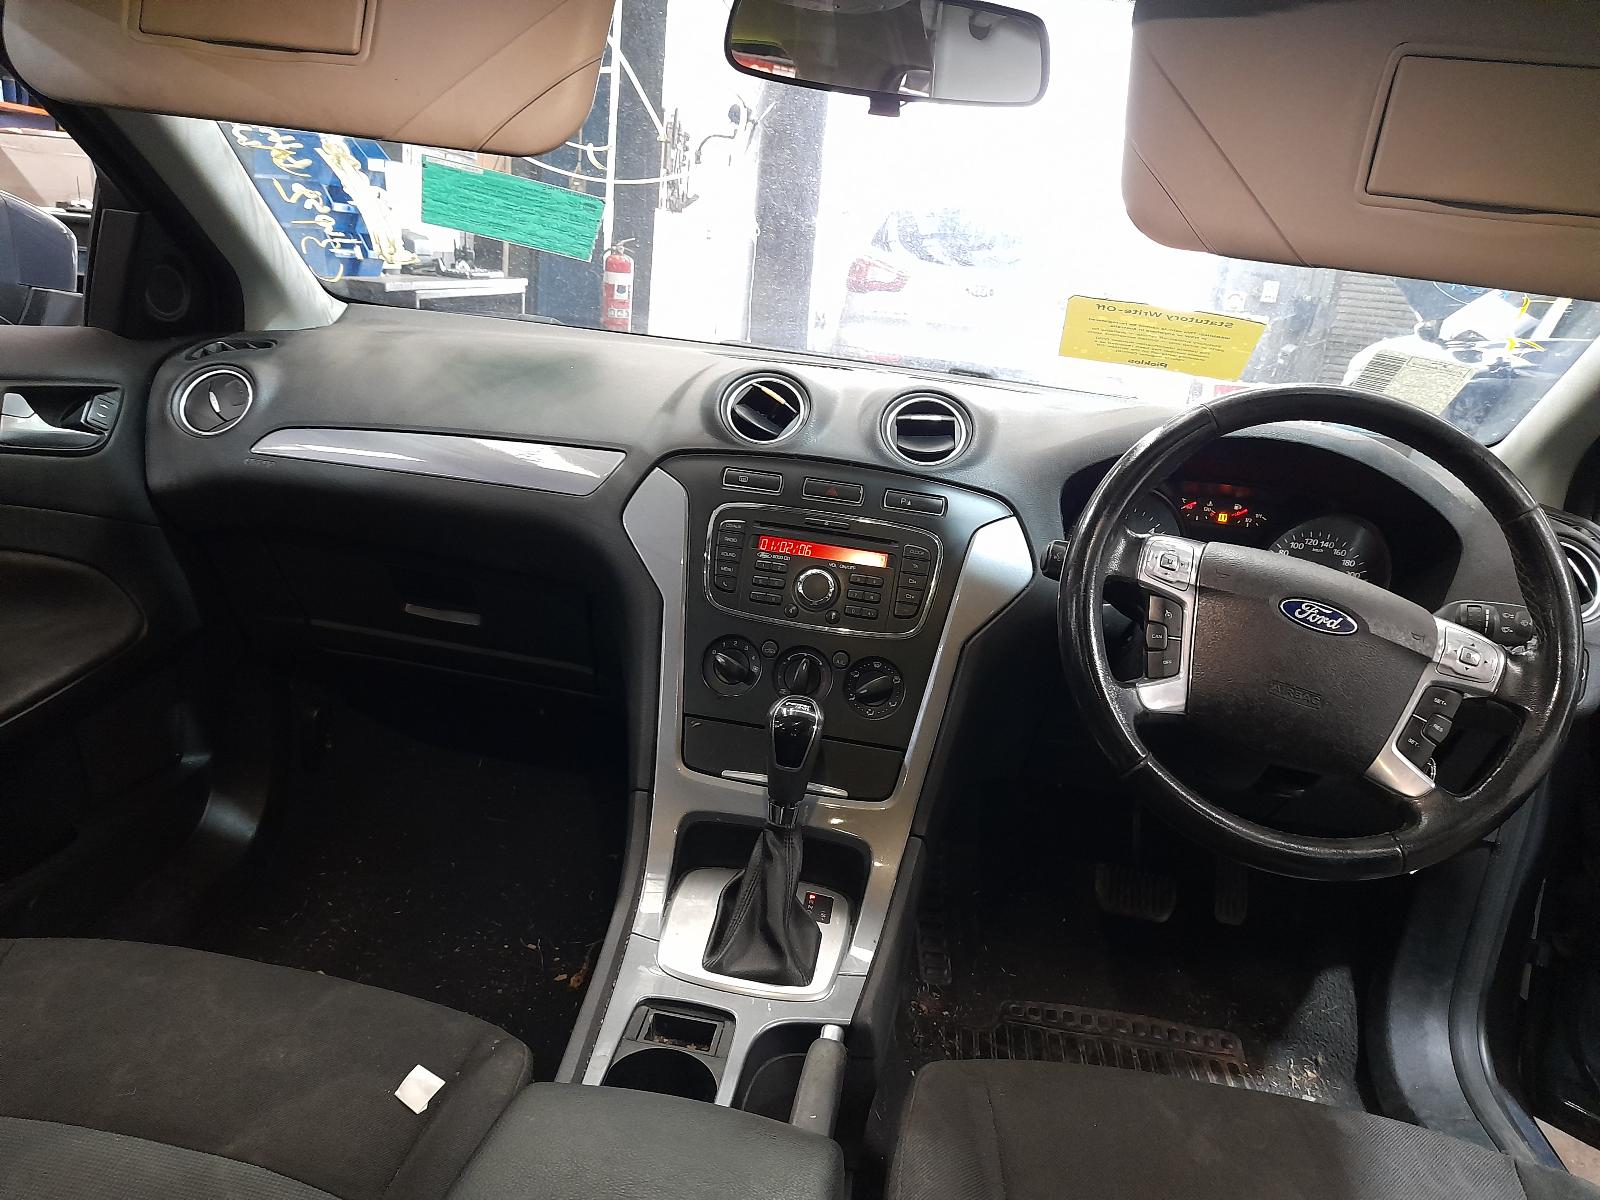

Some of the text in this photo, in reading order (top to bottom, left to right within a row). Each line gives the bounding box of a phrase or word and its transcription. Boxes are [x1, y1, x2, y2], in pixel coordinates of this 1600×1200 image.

[1290, 541, 1305, 550] 100
[1304, 538, 1319, 546] 120
[1320, 540, 1335, 549] 140
[760, 538, 813, 557] 01/02/06
[1333, 548, 1347, 557] 160
[1341, 559, 1356, 567] 180
[1294, 602, 1344, 630] Ford
[1432, 723, 1444, 733] RES
